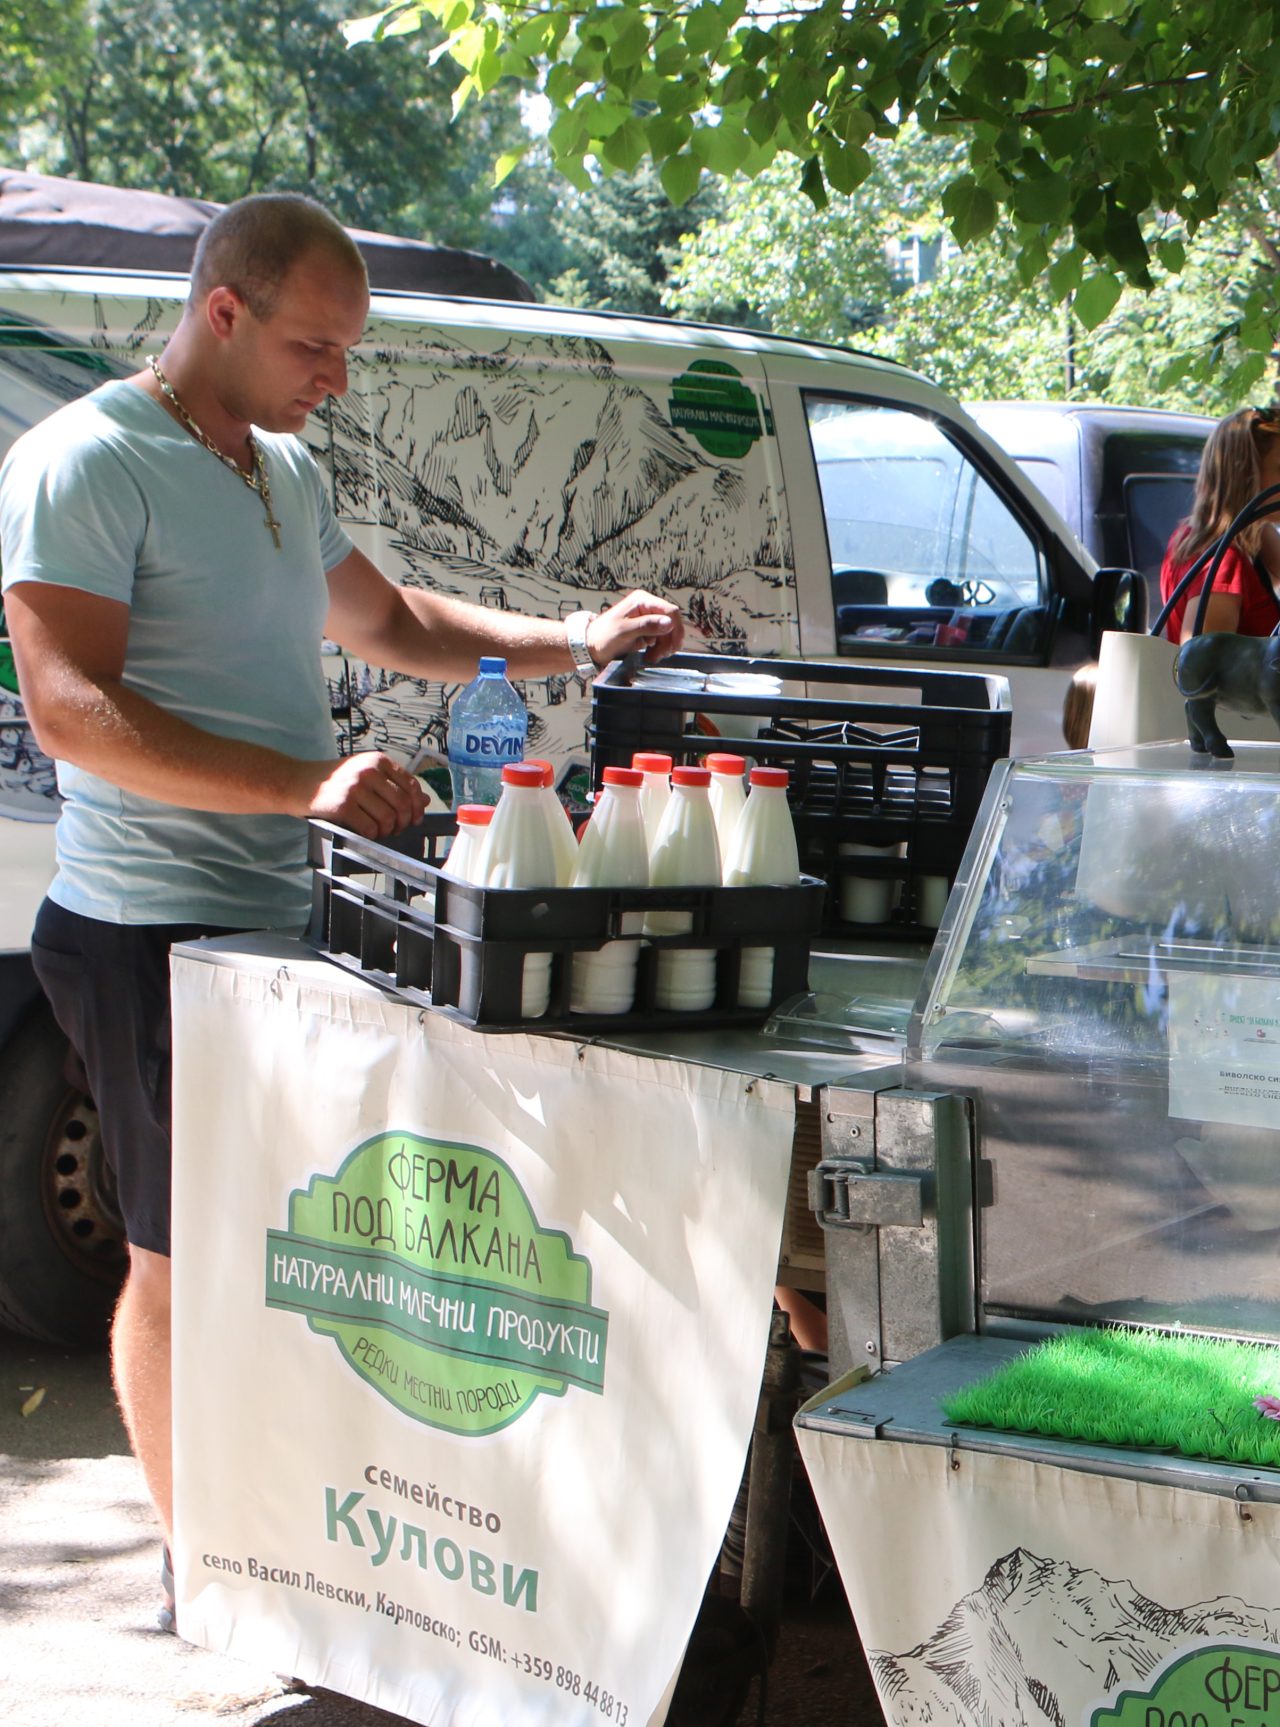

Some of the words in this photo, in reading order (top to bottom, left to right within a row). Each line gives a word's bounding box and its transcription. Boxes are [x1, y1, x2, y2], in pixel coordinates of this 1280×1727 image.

[466, 734, 524, 755] DEVIN
[1219, 1070, 1266, 1082] БИВОЛСКО
[388, 1143, 500, 1217] ФЕРМА
[332, 1191, 396, 1251] ПОД
[404, 1207, 542, 1284] БАЛКАНА
[273, 1254, 394, 1305] НАТУРАЛНИ
[400, 1281, 475, 1333] МЛЕЧНИ
[487, 1307, 599, 1364] ПРОДУКТИ
[352, 1336, 398, 1384] РЕДКИ
[404, 1370, 452, 1411] МЕСТНИ
[456, 1380, 521, 1415] ПОРОДИ
[364, 1464, 501, 1534] семейство
[325, 1486, 539, 1613] Кулови
[202, 1552, 242, 1576] село
[248, 1558, 300, 1589] Васил
[304, 1571, 371, 1612] Левски,
[375, 1590, 461, 1648] Карловско;
[468, 1630, 506, 1664] GSM:
[511, 1652, 553, 1680] +359
[556, 1665, 581, 1696] 898
[583, 1681, 599, 1707] 44
[600, 1690, 614, 1717] 88
[615, 1701, 628, 1727] 13
